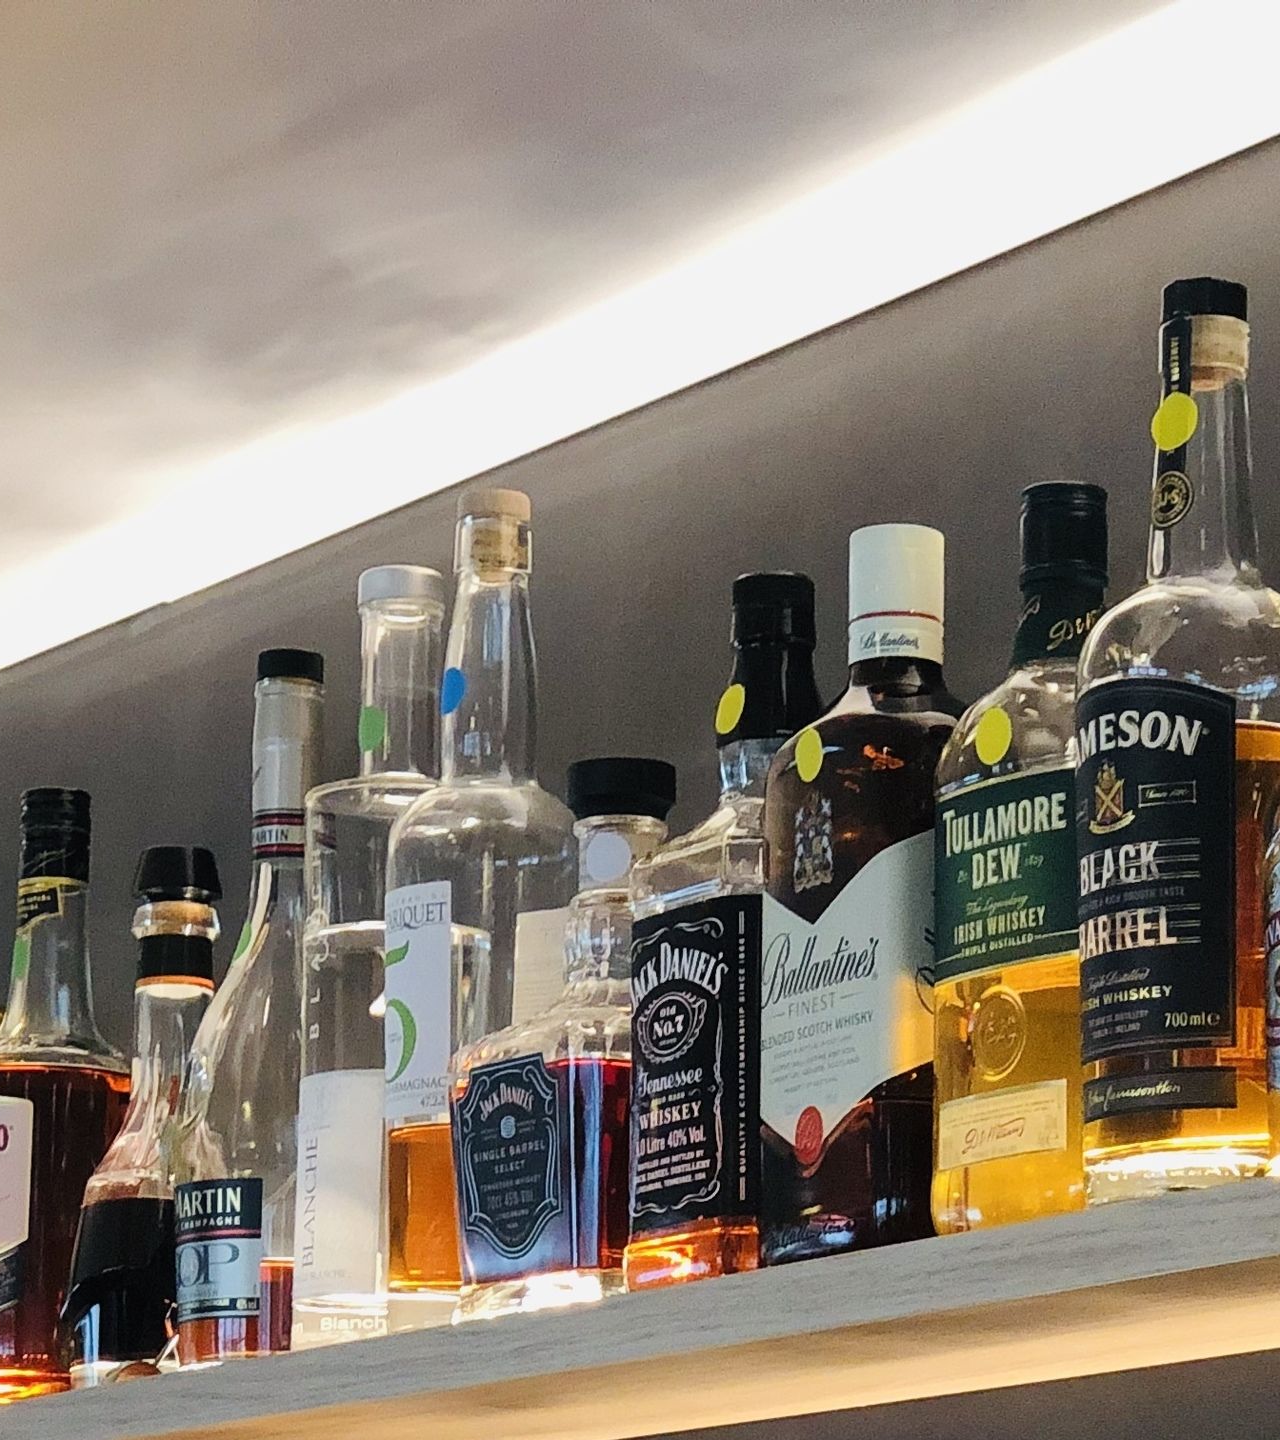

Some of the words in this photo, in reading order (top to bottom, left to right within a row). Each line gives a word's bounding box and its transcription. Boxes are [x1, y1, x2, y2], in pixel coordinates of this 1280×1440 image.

[253, 829, 289, 844] ARTIN
[943, 792, 1066, 857] TULLAMORE
[1080, 841, 1161, 897] BLACK
[954, 923, 983, 945] IRISH
[987, 905, 1045, 936] WHISKEY
[989, 932, 1033, 950] DISTILLED
[1079, 906, 1178, 962] BARREL
[660, 942, 729, 995] DANIEL'S
[738, 967, 746, 1003] SINCE
[761, 933, 879, 1010] Ballantine's
[788, 991, 836, 1019] FINEST
[1103, 985, 1173, 1005] WHISKEY
[797, 1020, 832, 1040] SCOTCH
[835, 1010, 874, 1029] WHISKY
[738, 1006, 746, 1108] CRAFTSMANSHIP
[479, 1091, 501, 1121] JACK
[640, 1100, 701, 1130] WHISKEY
[474, 1147, 506, 1164] SINGLE
[509, 1139, 546, 1157] BARREL
[667, 1128, 687, 1148] 40%
[738, 1122, 746, 1173] QUALITY
[494, 1159, 527, 1174] SELECT
[301, 1137, 318, 1267] BLANCHE
